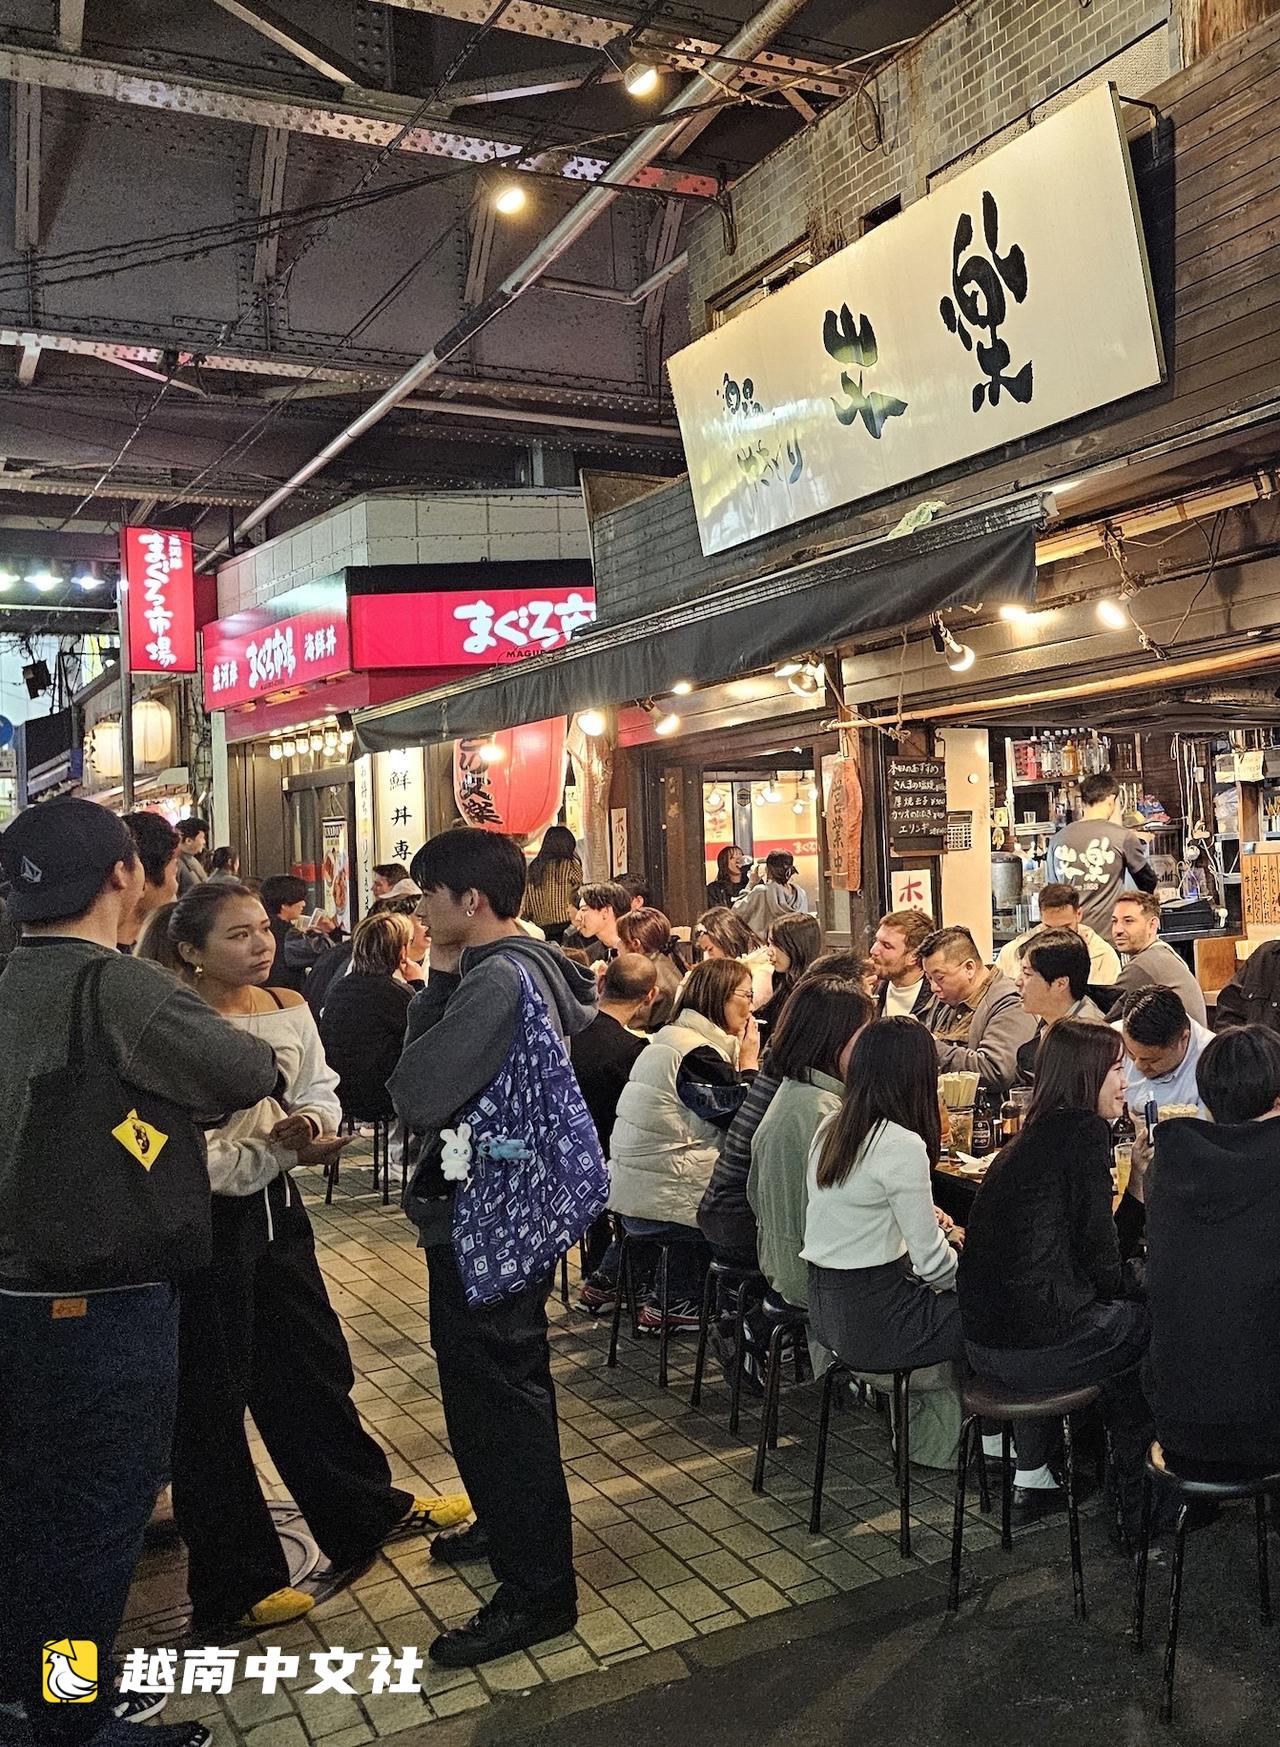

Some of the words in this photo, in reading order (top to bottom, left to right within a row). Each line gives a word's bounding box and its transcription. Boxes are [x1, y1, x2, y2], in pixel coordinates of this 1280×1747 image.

[138, 533, 178, 668] まぐろ市場
[246, 626, 296, 688] まぐろ市場
[389, 750, 413, 861] 鮮丼専
